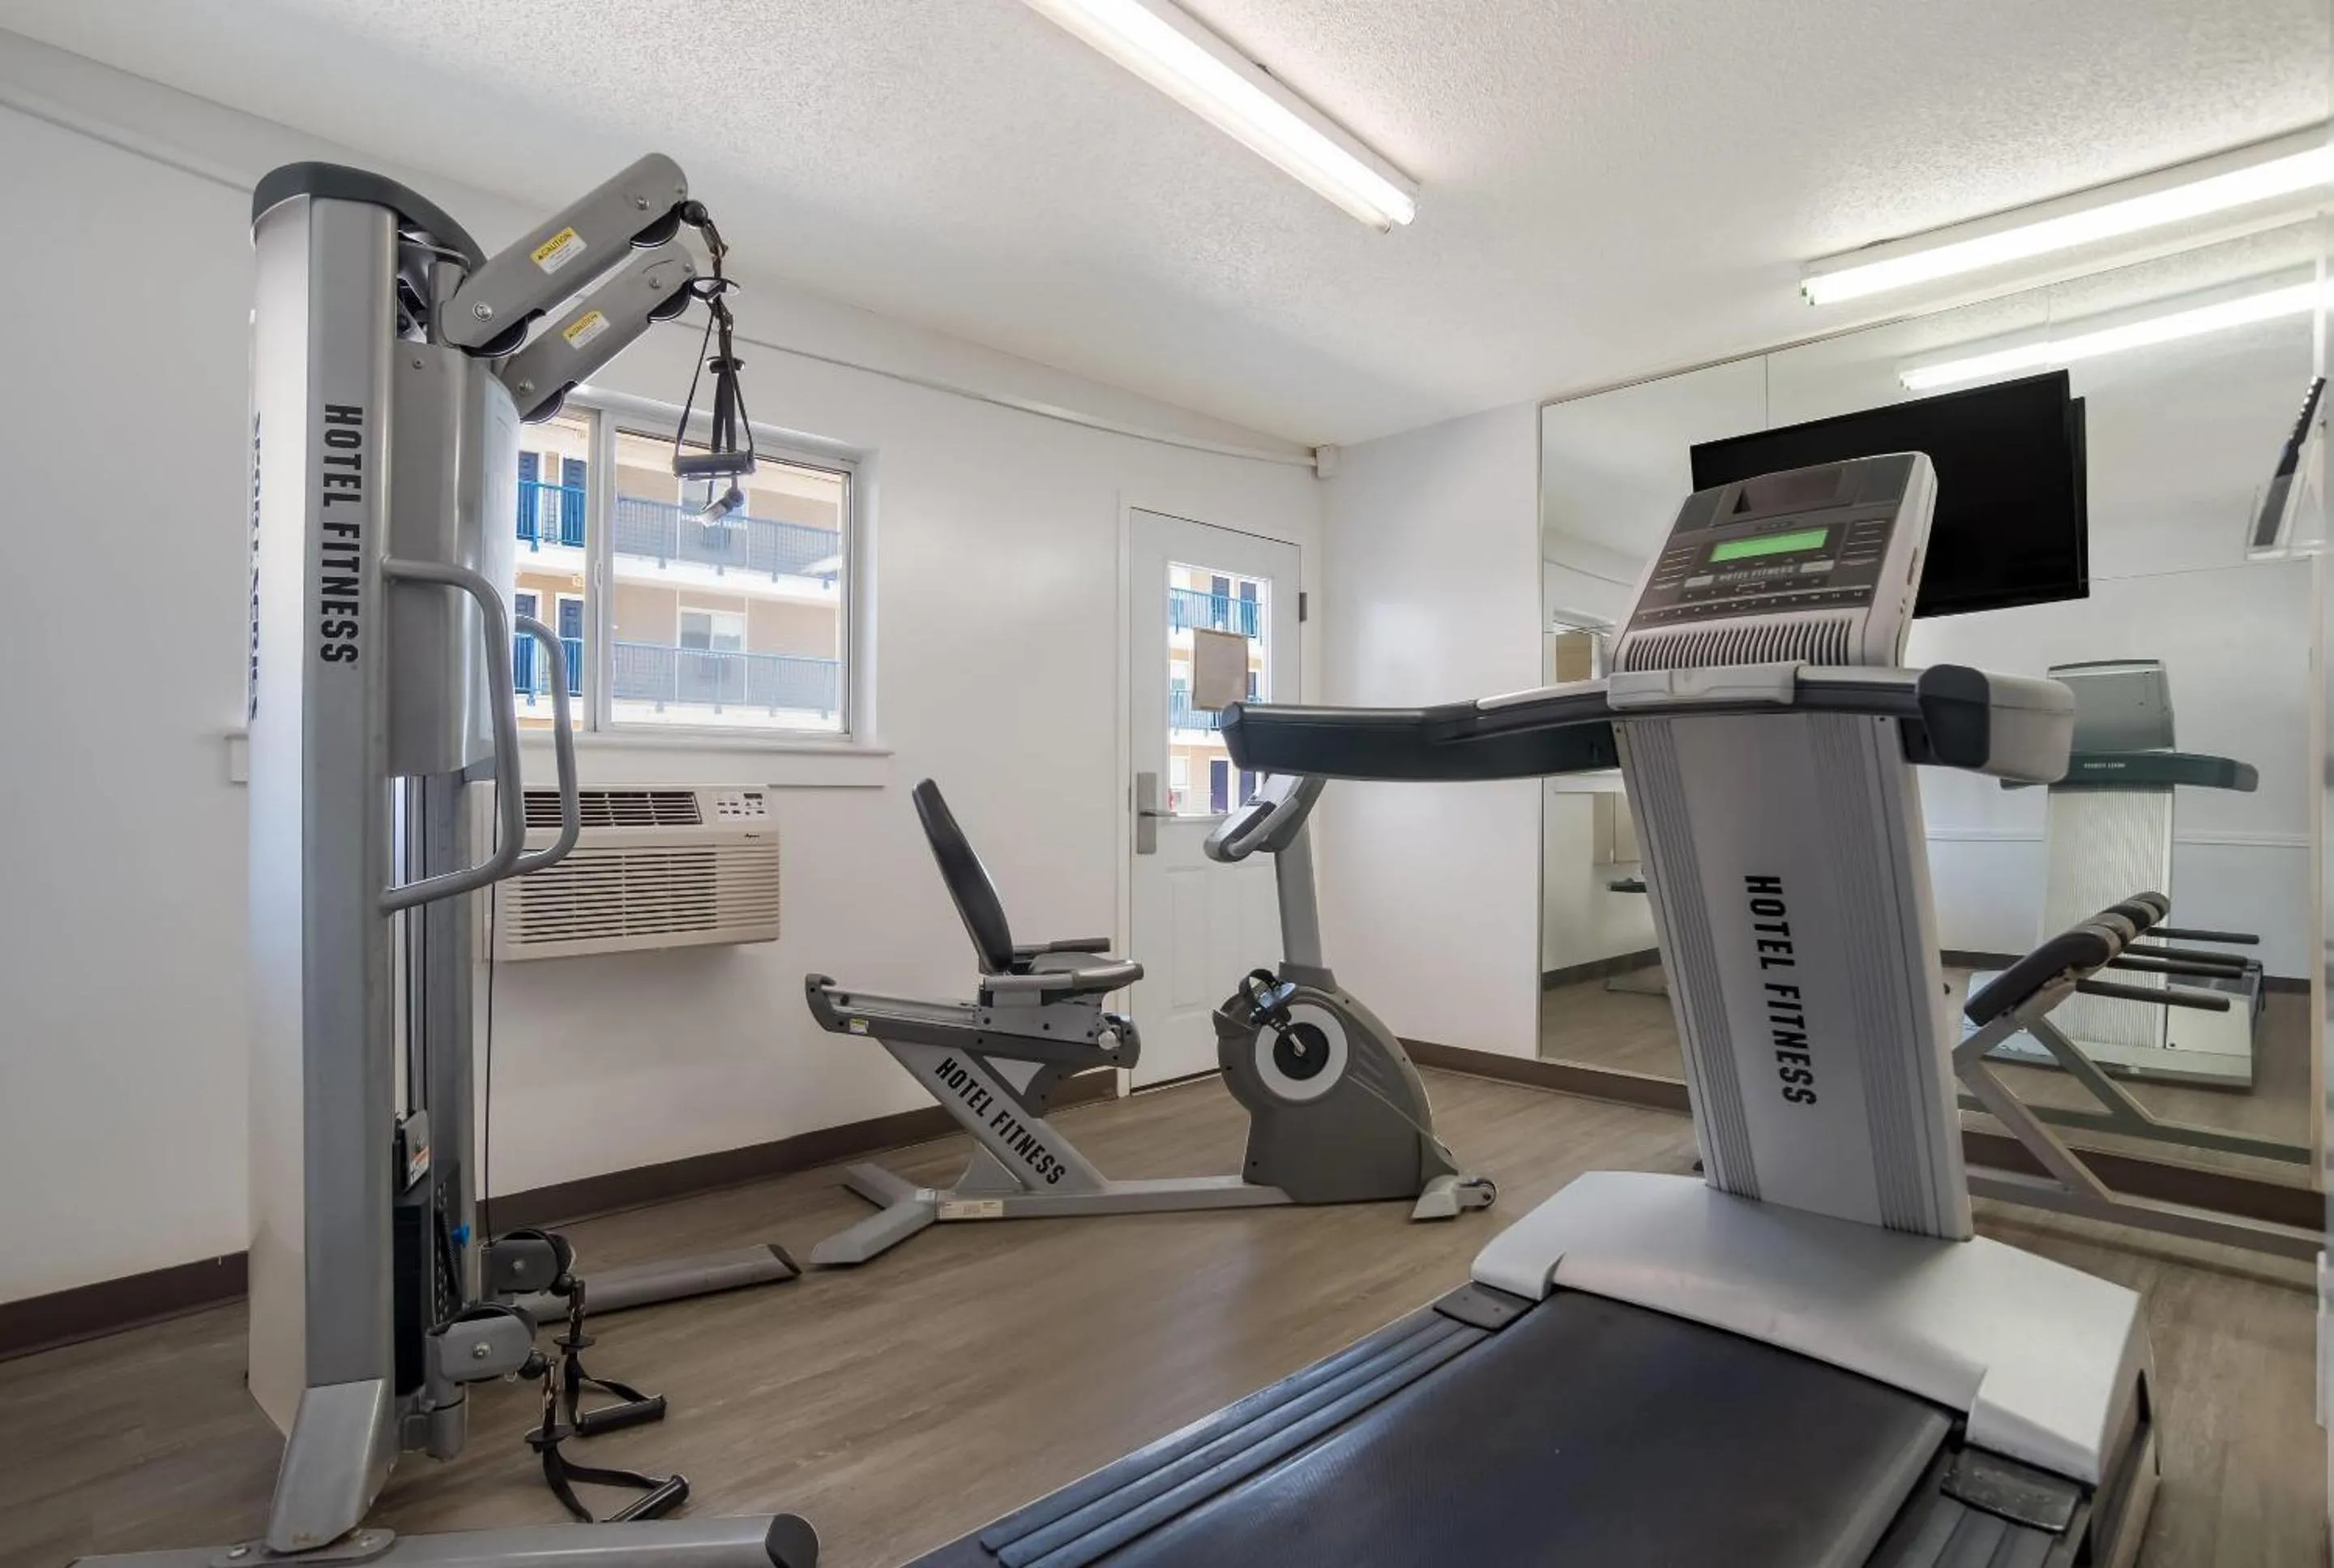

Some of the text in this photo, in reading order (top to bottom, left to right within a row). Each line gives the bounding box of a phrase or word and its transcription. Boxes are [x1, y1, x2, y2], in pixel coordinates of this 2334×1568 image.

[320, 403, 364, 664] HOTEL FITNESS
[1744, 875, 1818, 1106] HOTEL FITNESS
[934, 1057, 1067, 1186] HOTEL FITNESS
